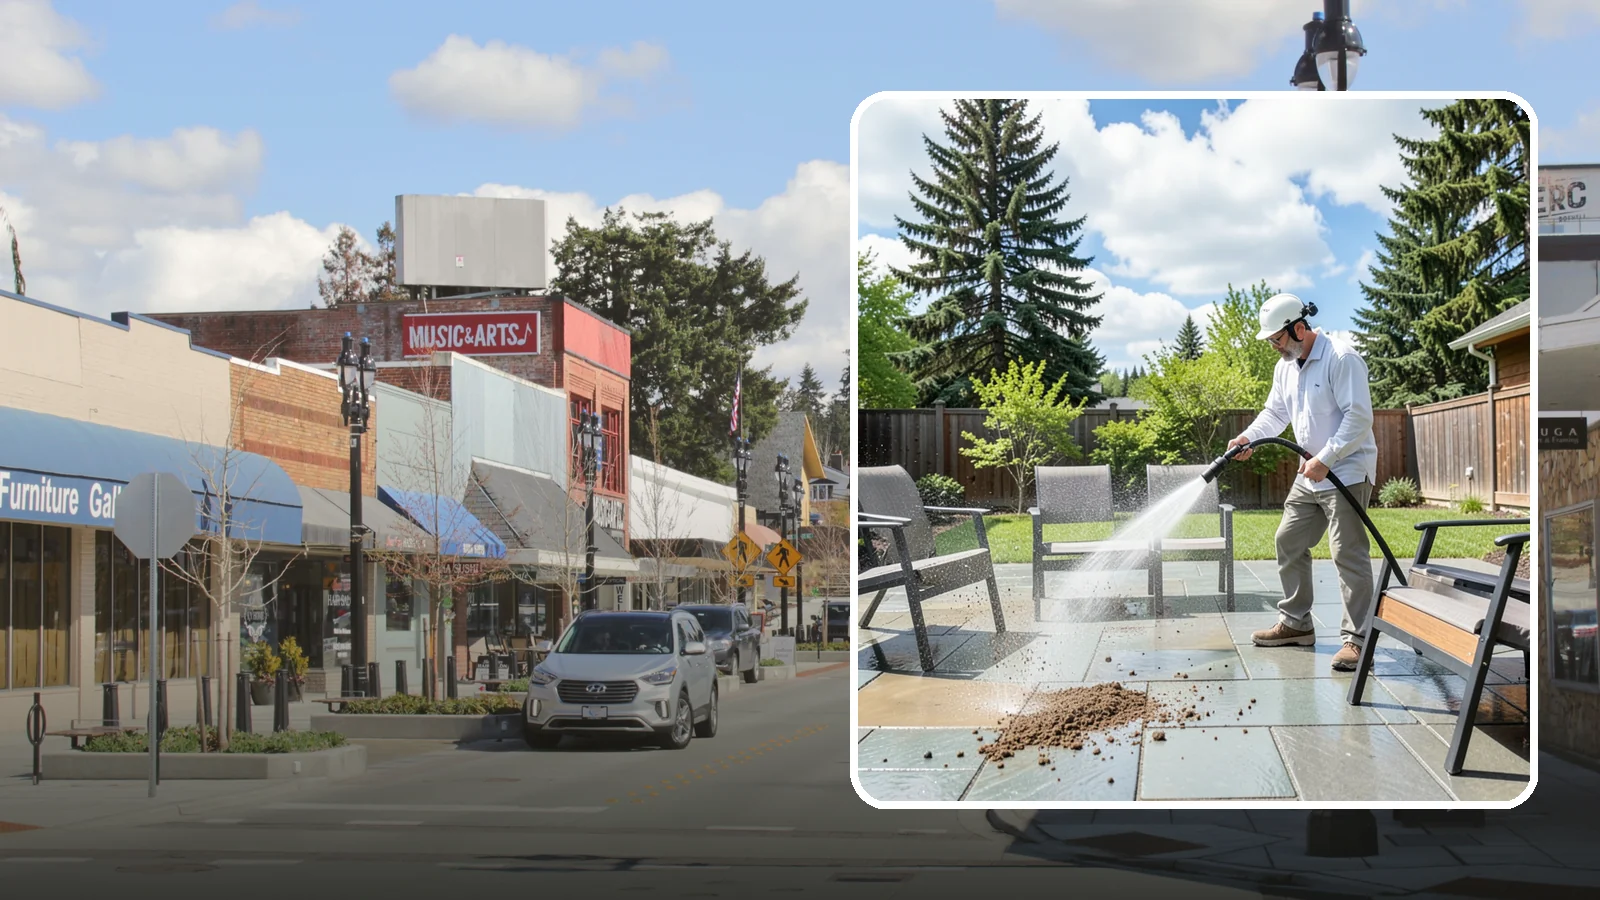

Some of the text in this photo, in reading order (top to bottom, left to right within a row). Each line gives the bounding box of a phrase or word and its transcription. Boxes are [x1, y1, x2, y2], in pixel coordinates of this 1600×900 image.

[409, 323, 519, 348] MUSIC&ARTS
[0, 471, 121, 519] Furniture Gal
[453, 563, 479, 574] SUSHI
